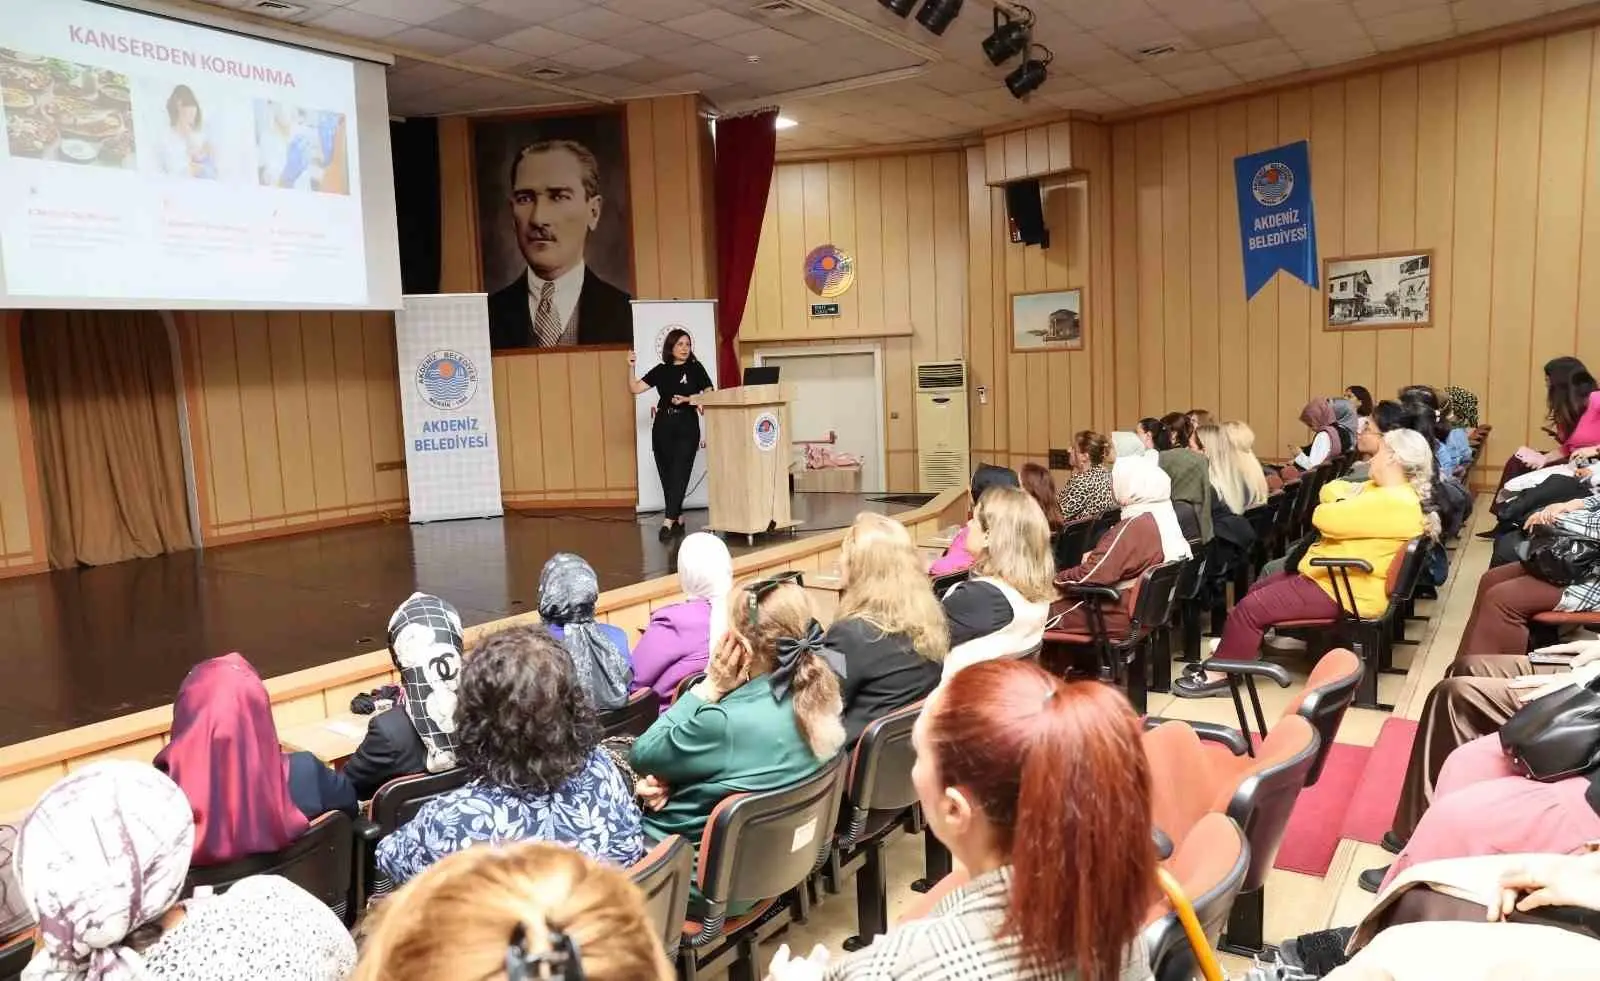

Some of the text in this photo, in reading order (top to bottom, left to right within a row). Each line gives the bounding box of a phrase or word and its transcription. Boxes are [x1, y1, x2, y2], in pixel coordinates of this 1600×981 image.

[69, 24, 296, 88] KANSERDEN KORUNMA
[1254, 207, 1300, 231] AKDENİZ
[1248, 223, 1307, 250] BELEDİYESİ
[422, 416, 479, 433] AKDENİZ
[414, 432, 489, 452] BELEDİYESİ
